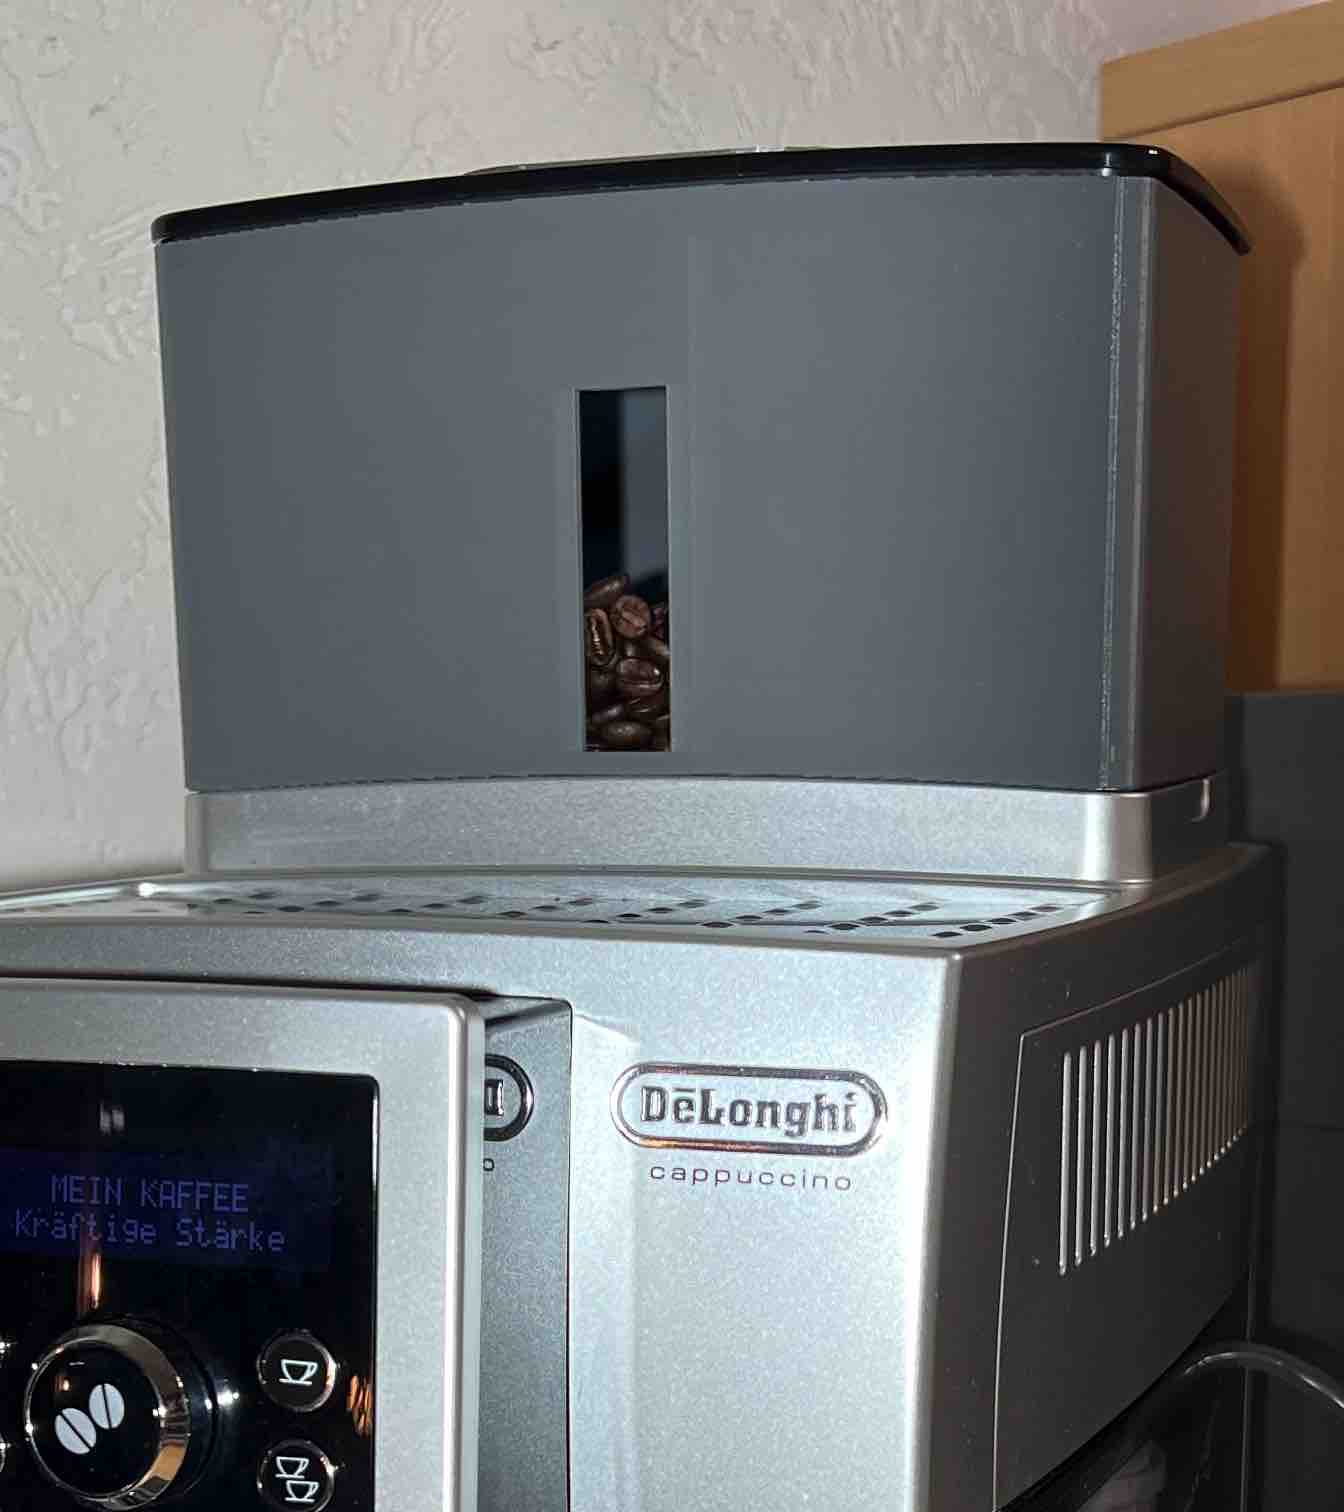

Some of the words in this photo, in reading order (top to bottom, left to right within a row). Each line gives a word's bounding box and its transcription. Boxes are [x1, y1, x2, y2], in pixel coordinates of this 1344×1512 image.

[50, 1175, 123, 1207] MEIN
[140, 1179, 249, 1213] KAFFEE
[649, 1163, 852, 1192] cappuccino
[14, 1207, 158, 1245] Kräftige
[175, 1216, 286, 1252] Stärke
